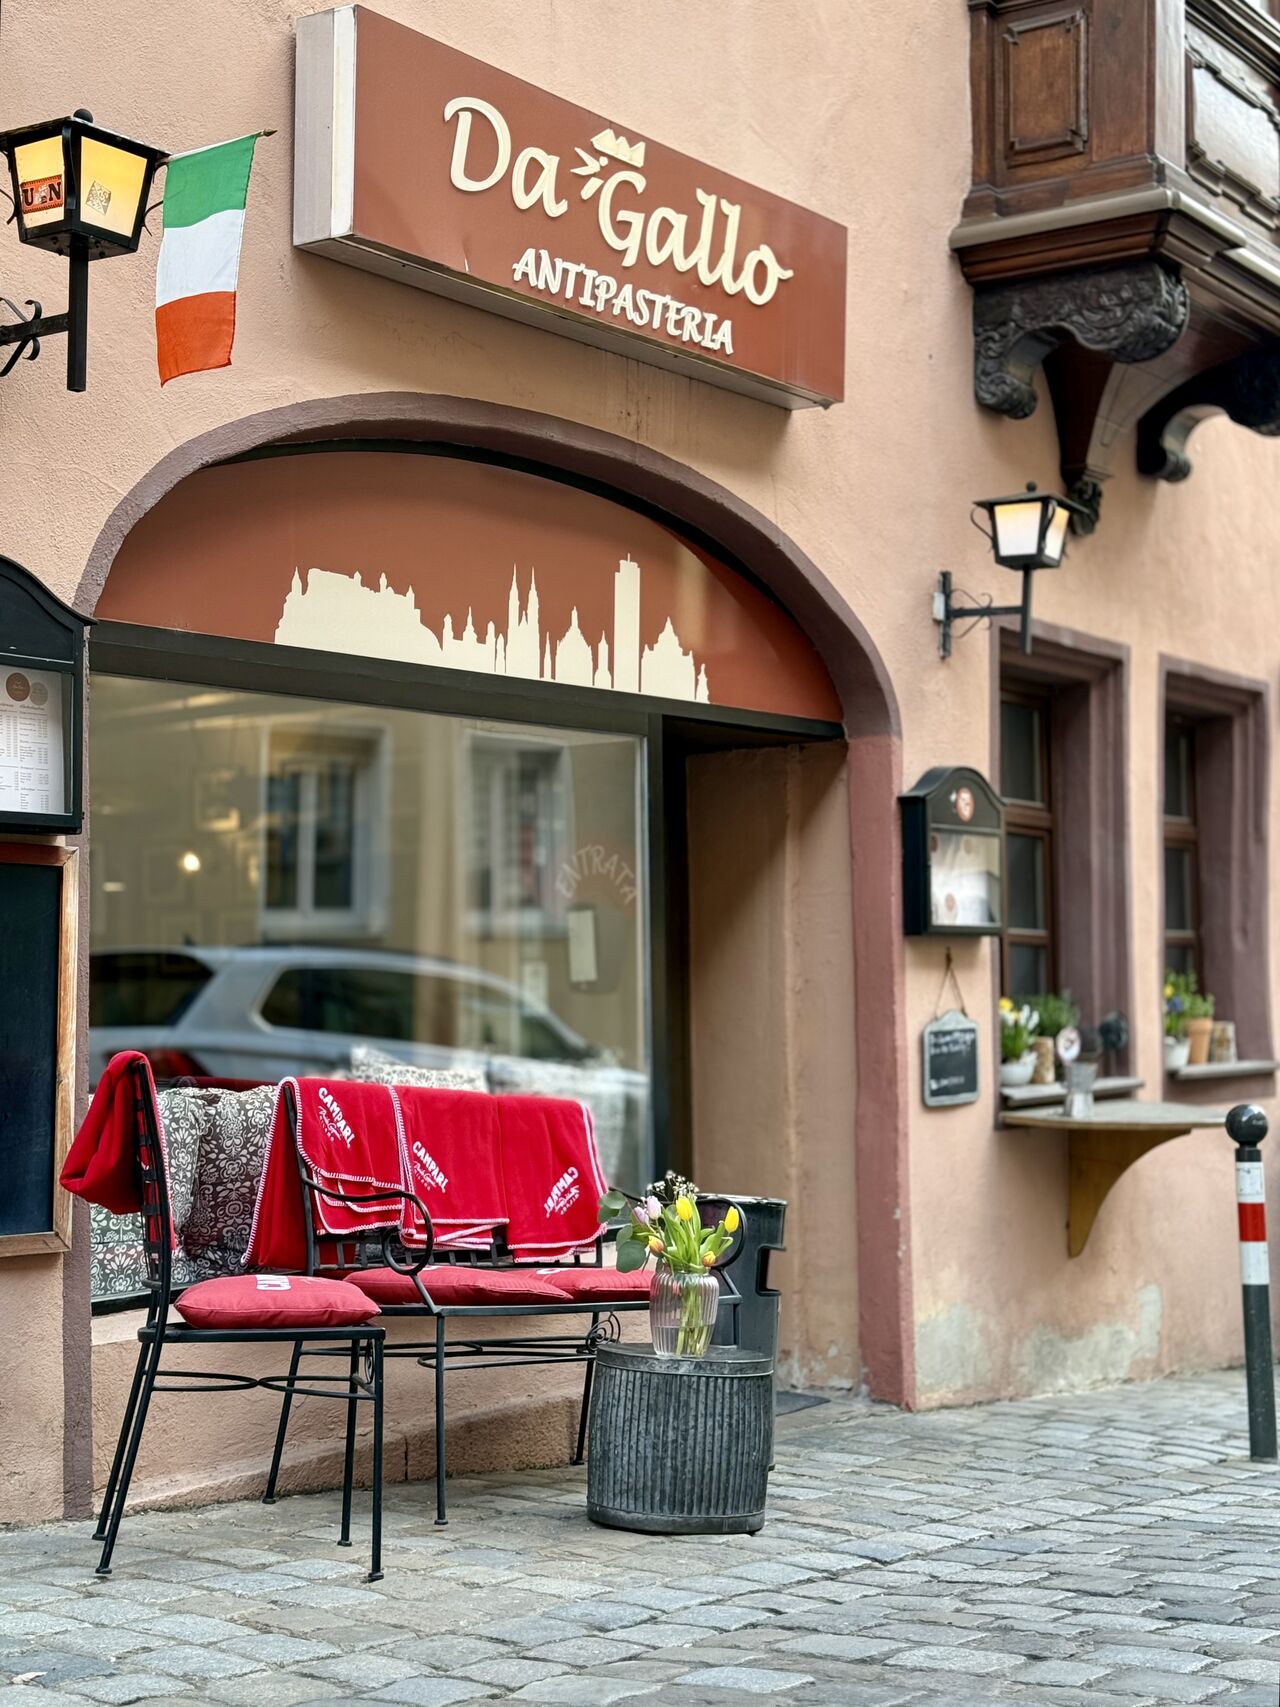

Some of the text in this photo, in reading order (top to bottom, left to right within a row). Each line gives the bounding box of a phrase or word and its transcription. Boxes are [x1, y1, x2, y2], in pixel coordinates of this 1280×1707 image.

[443, 97, 794, 306] Da Gallo
[512, 247, 735, 355] ANTIPASTERIA
[555, 844, 637, 905] ENTRATA
[318, 1087, 355, 1144] CAMPARI
[413, 1141, 448, 1189] CAMPARI
